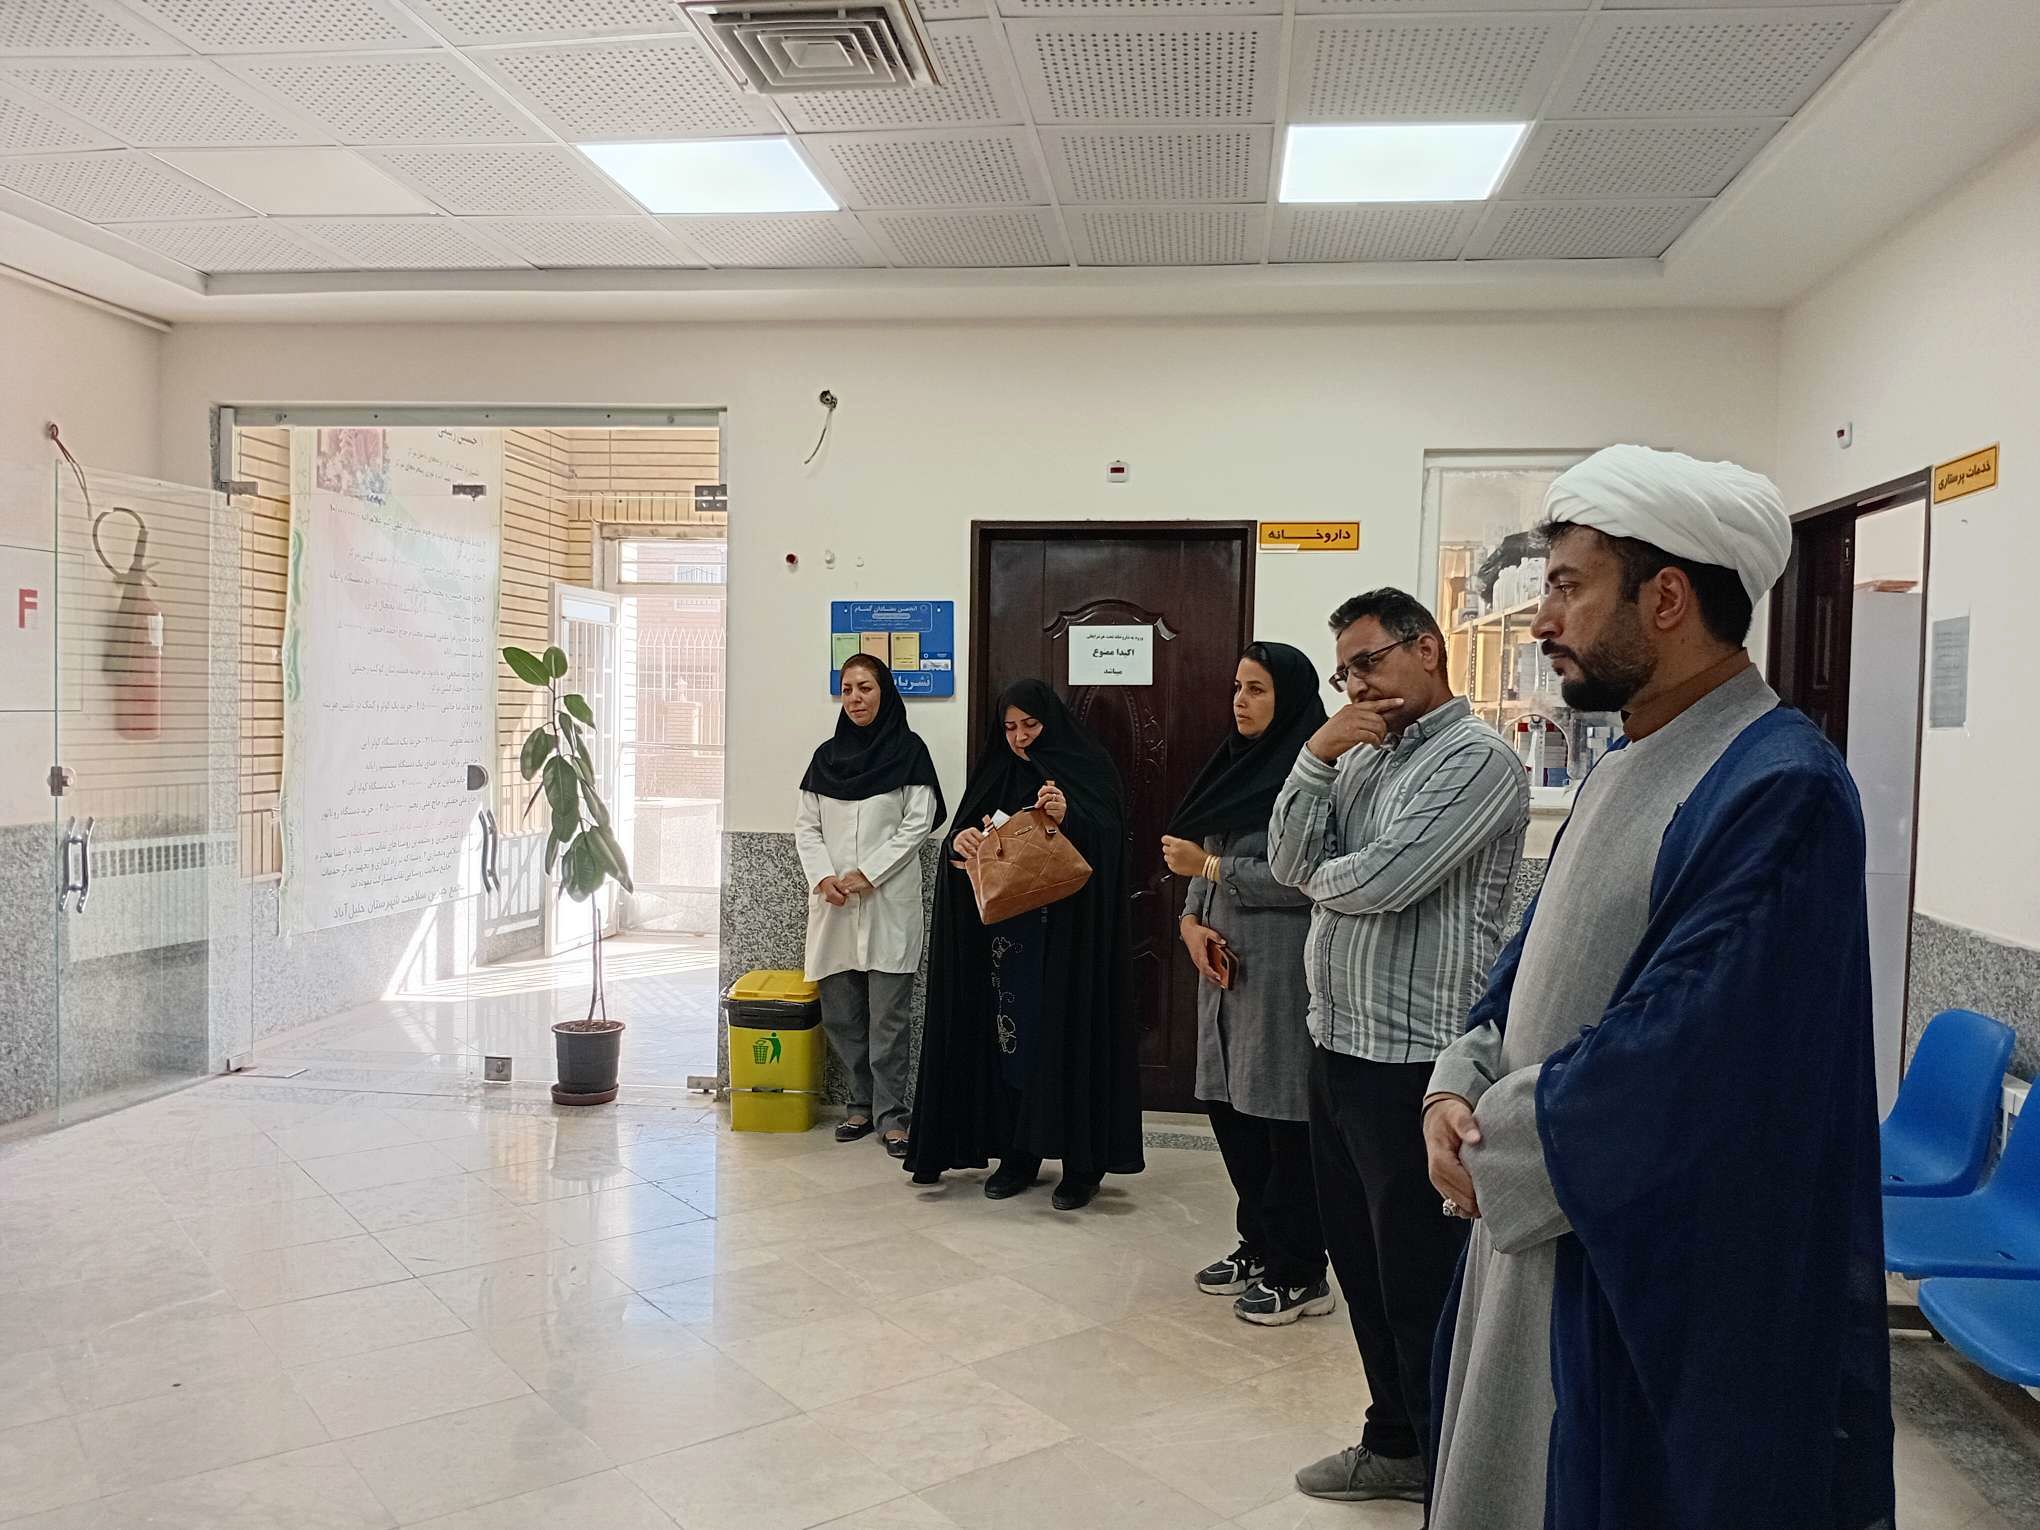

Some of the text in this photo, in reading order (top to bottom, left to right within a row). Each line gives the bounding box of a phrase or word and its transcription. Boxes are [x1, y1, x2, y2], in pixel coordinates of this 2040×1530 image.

[1938, 460, 1991, 491] خدمات پرستاری
[1268, 529, 1351, 543] داروخانه
[18, 588, 39, 629] F
